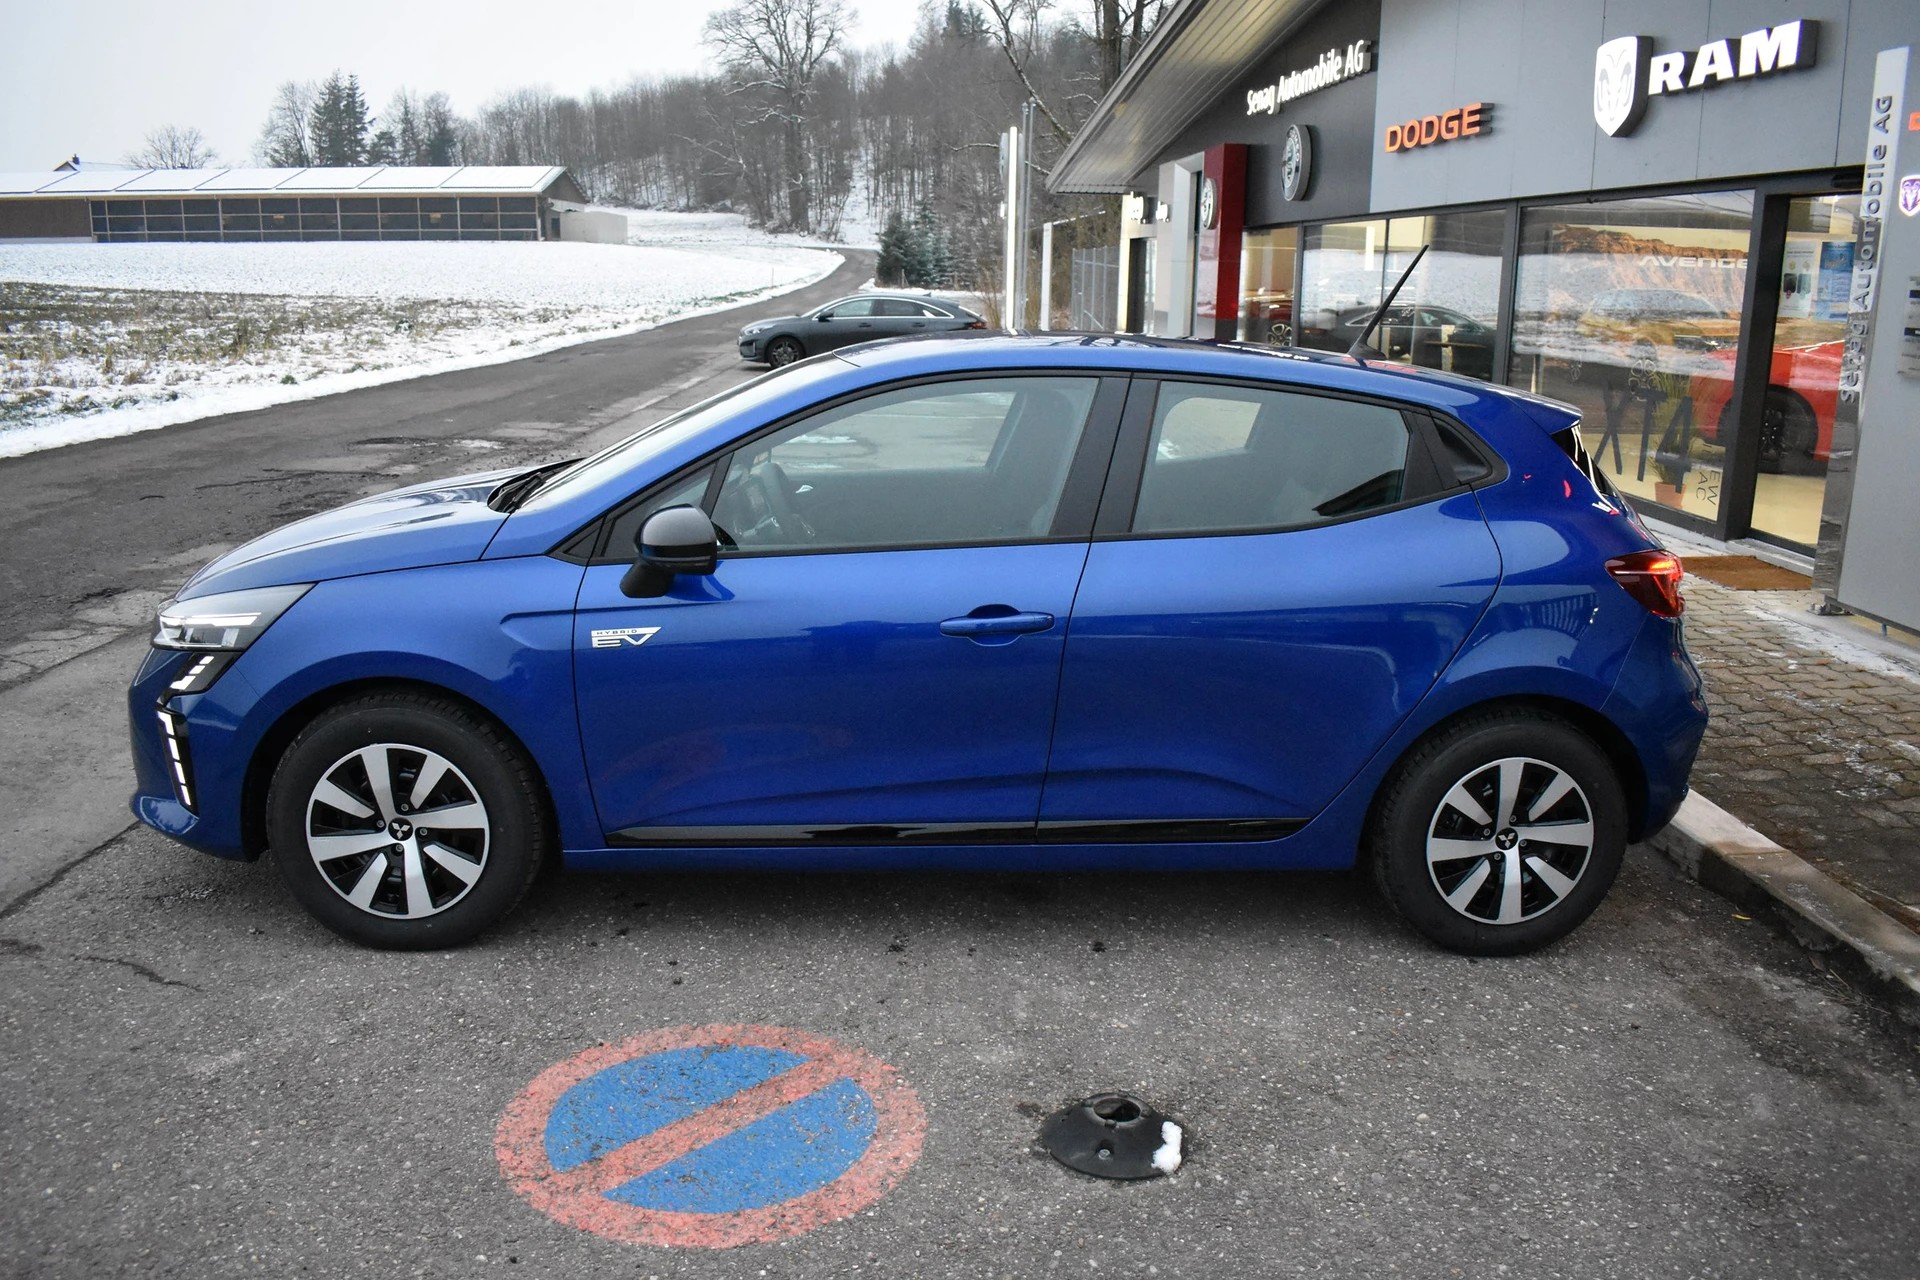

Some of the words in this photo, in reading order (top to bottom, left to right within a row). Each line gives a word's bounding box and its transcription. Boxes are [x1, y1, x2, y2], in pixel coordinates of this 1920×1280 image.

[1246, 85, 1276, 116] Senag
[1277, 48, 1342, 103] Automobile
[1344, 39, 1365, 77] AG
[1648, 20, 1801, 95] RAM
[1384, 101, 1482, 153] DODGE
[1853, 144, 1887, 311] Automobile
[1873, 95, 1893, 135] AG
[1638, 255, 1748, 269] AVENGE
[591, 633, 655, 649] EV
[596, 628, 638, 636] HYBRID
